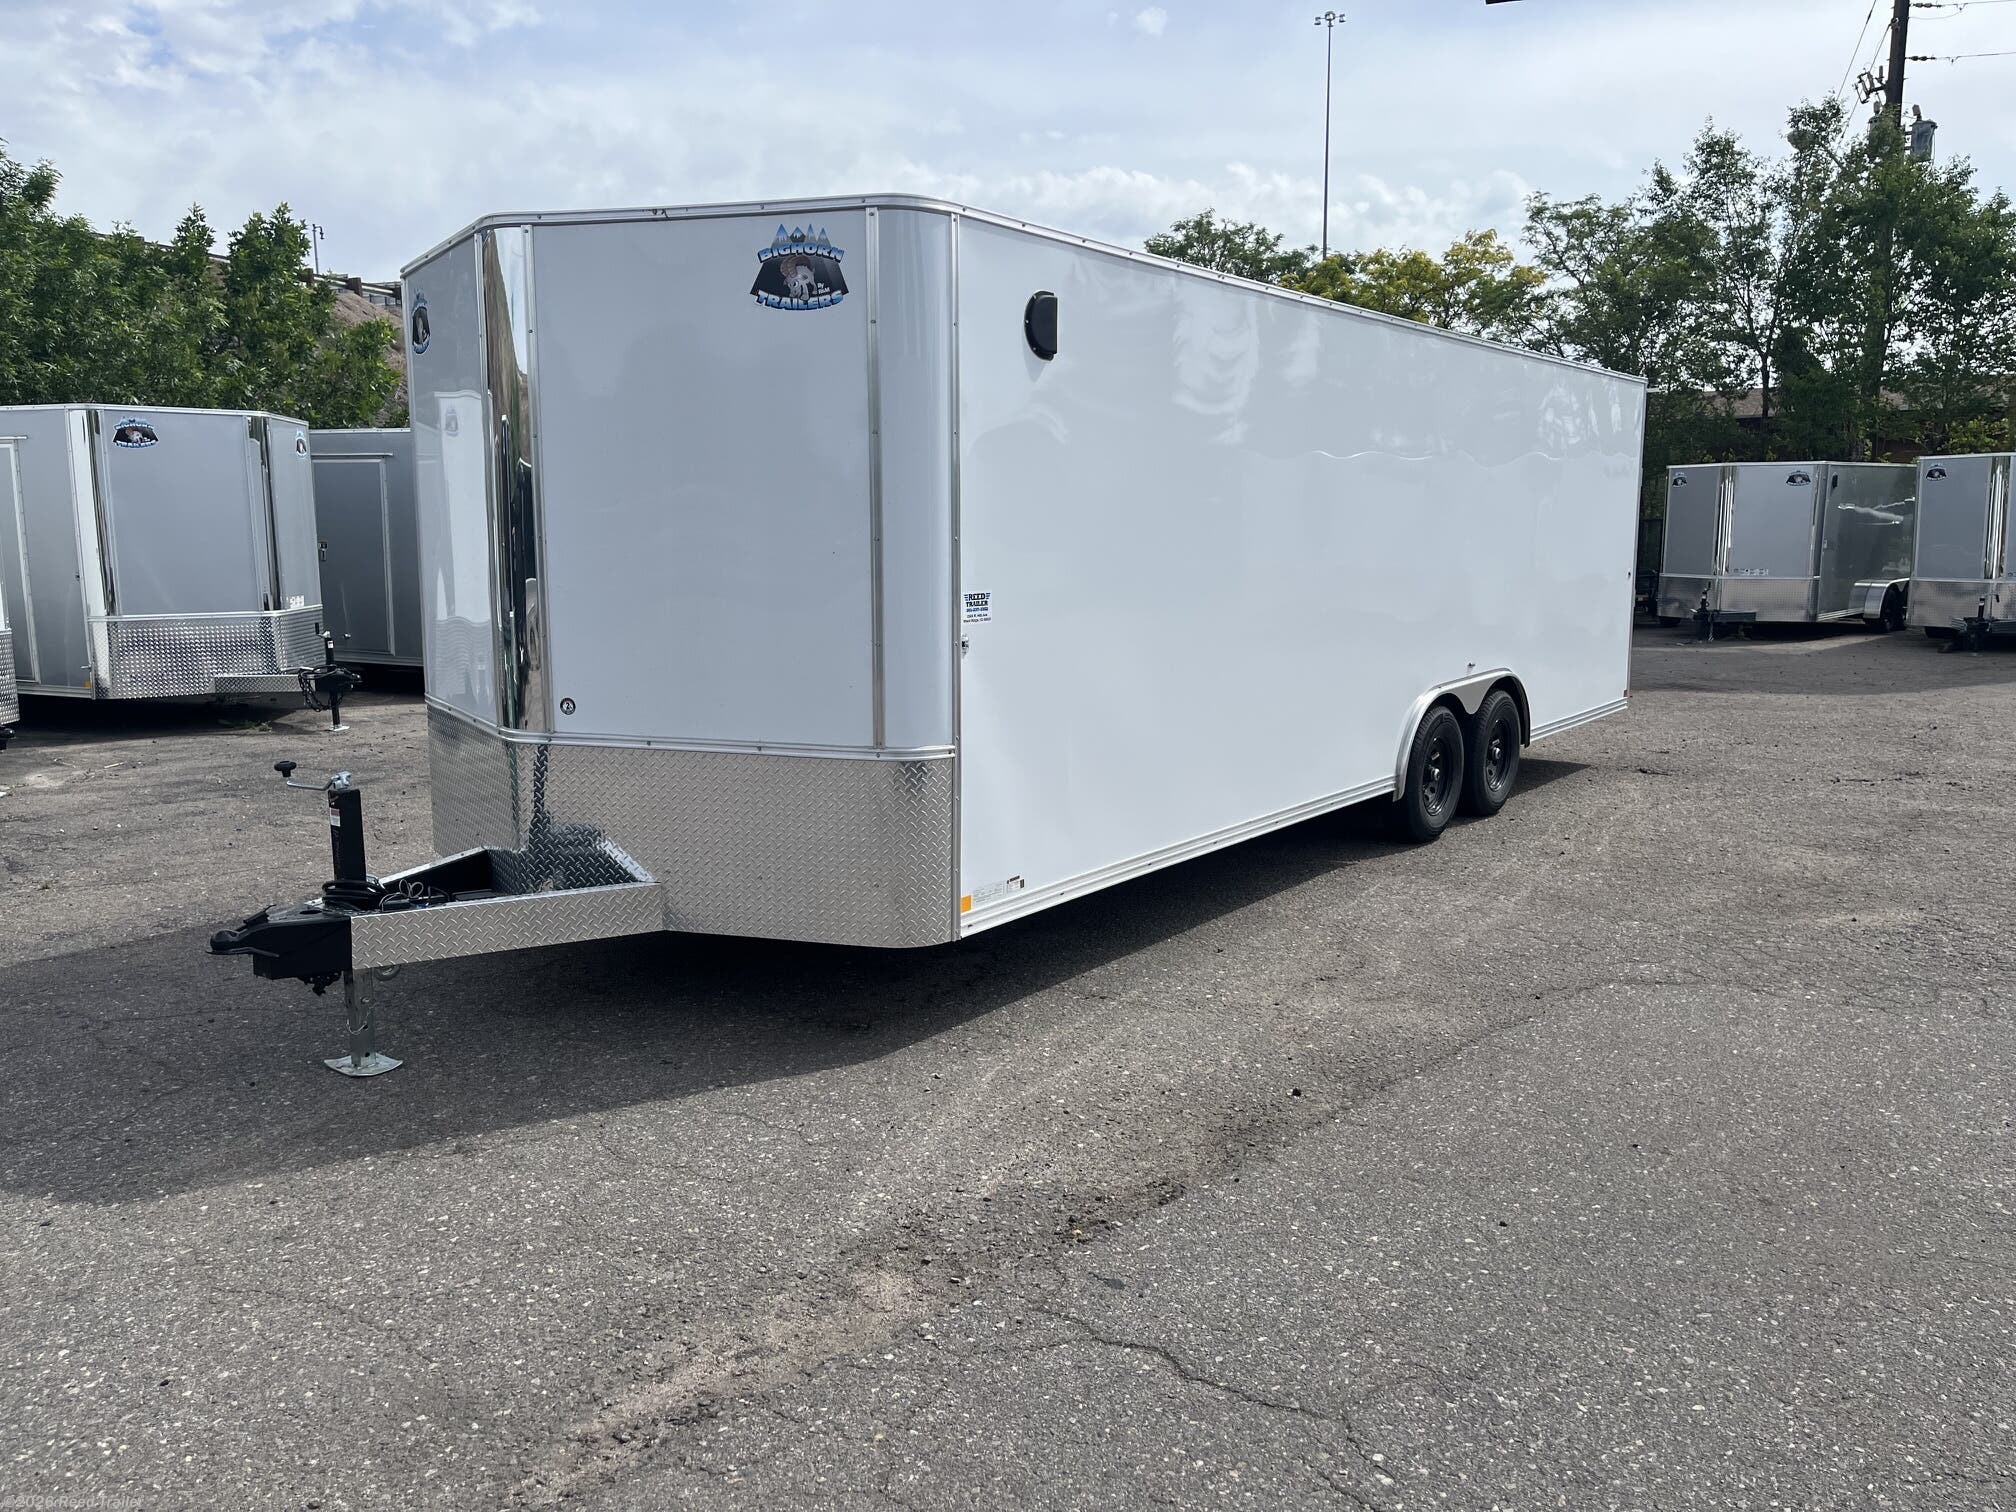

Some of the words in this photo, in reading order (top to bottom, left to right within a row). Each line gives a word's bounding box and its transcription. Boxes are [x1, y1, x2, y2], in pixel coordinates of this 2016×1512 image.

[758, 242, 844, 263] BIGHORN
[755, 289, 844, 310] TRAILERS
[966, 600, 988, 608] TRAILER
[968, 593, 986, 601] REED
